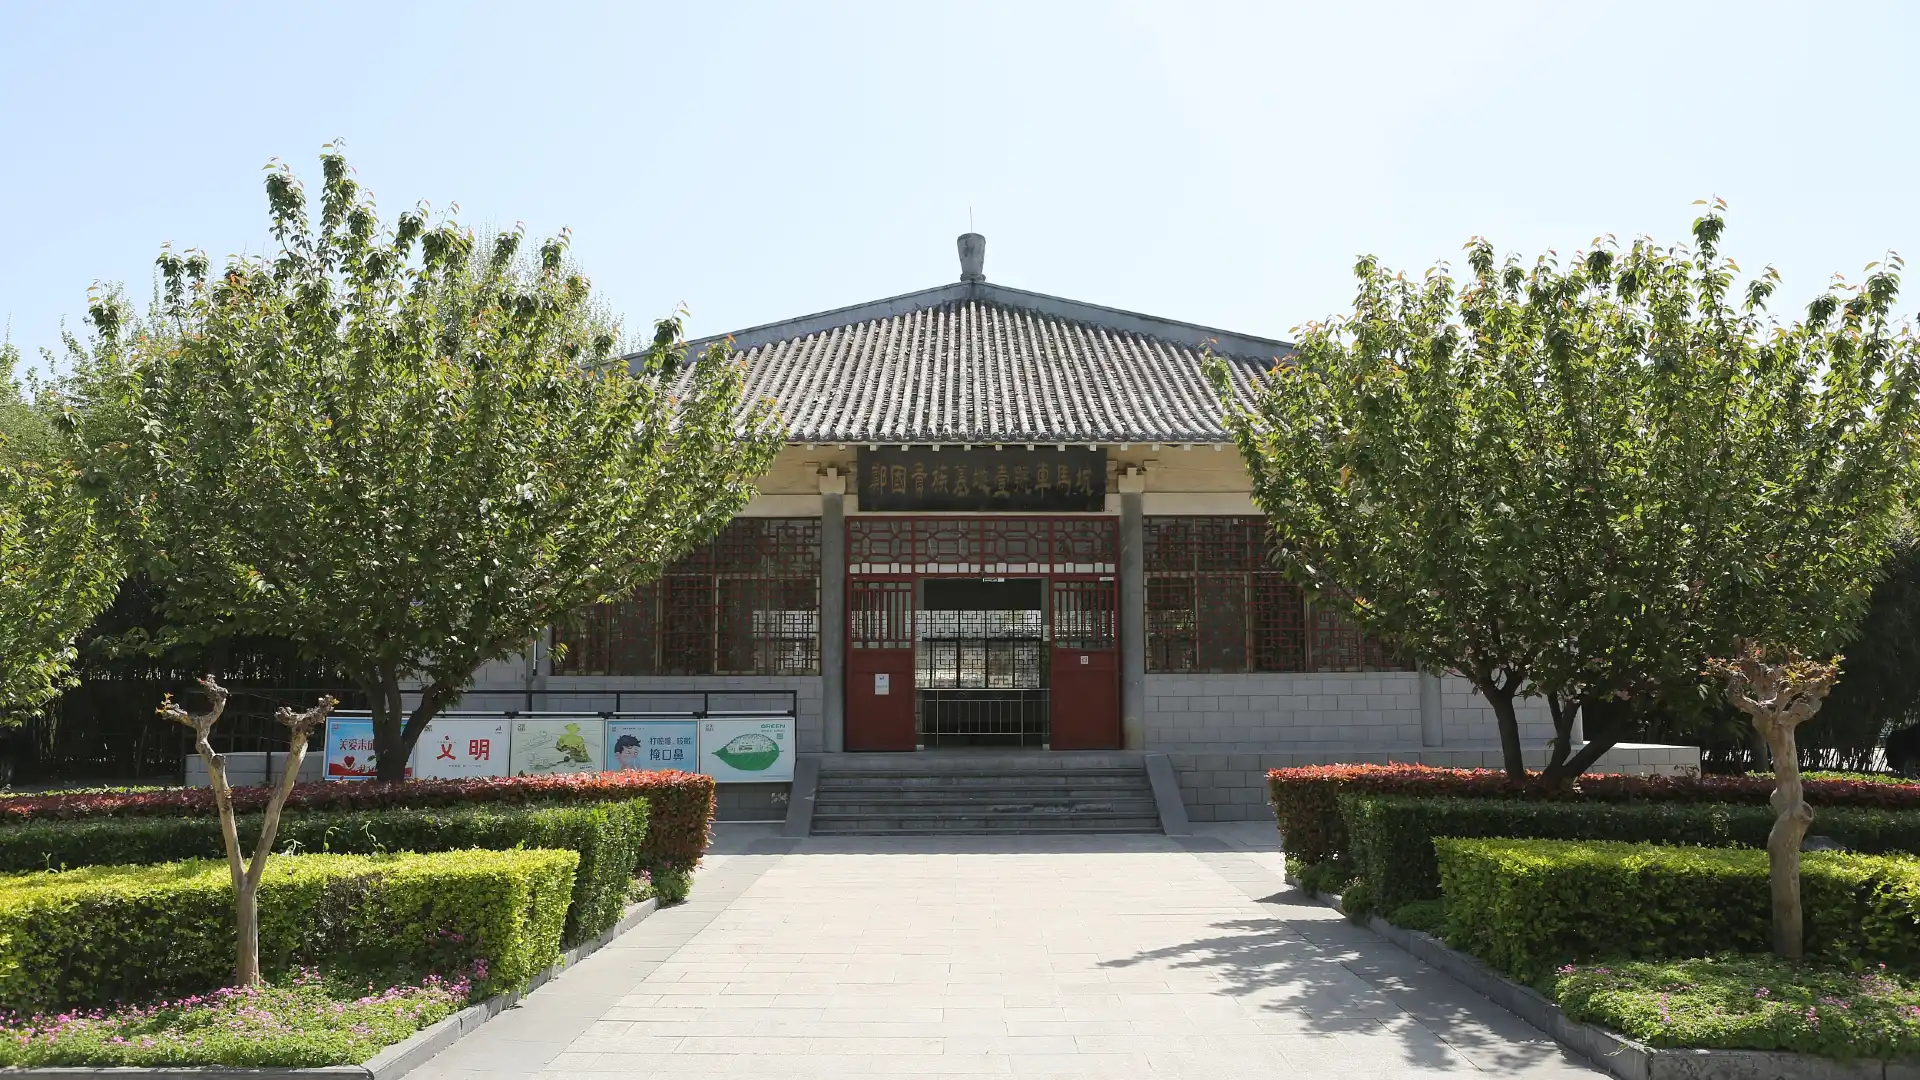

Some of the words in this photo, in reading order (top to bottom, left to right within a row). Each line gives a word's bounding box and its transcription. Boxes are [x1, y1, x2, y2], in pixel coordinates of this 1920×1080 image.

[436, 735, 490, 761] 文明
[650, 748, 685, 761] 掩口鼻
